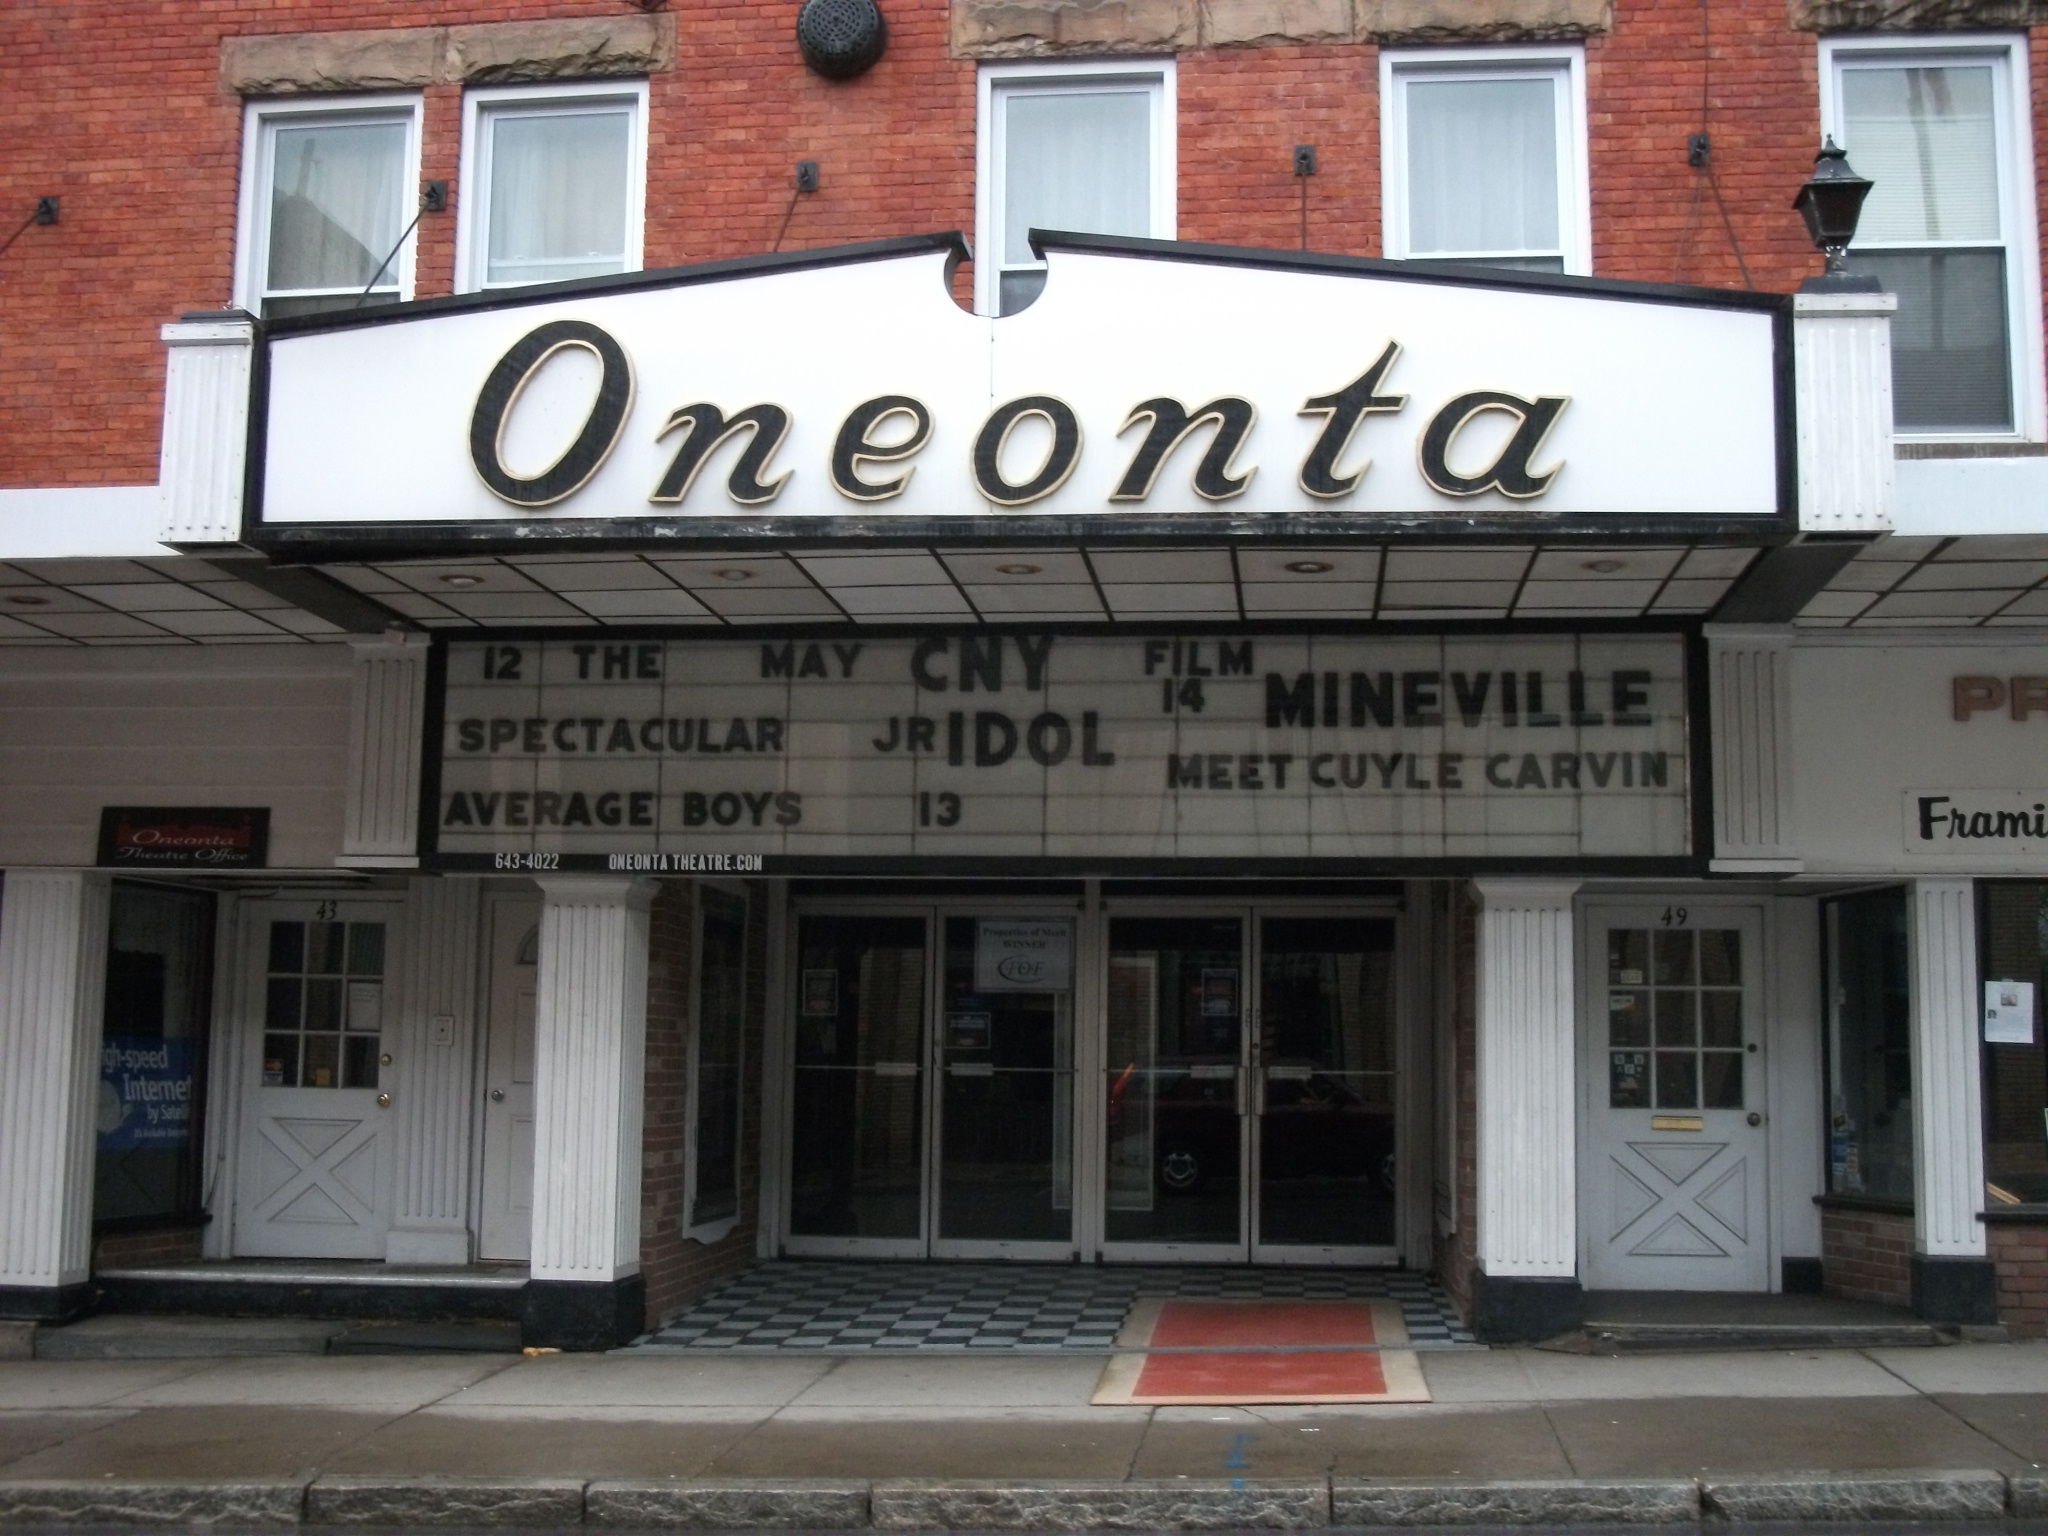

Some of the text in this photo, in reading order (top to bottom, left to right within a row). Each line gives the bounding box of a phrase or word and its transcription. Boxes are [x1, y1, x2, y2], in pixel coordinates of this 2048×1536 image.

[466, 320, 1572, 506] Oneonta
[483, 644, 661, 680] 12 THE
[761, 643, 865, 679] MAY
[911, 635, 1054, 692] CNY
[1144, 640, 1254, 677] FILM
[1162, 678, 1205, 713] 14
[1265, 671, 1653, 729] MINEVILLE
[458, 717, 784, 755] SPECTACULAR
[873, 711, 1115, 768] JR IDOL
[1167, 751, 1669, 792] MEET CUYLE CARVIN
[444, 791, 802, 828] AVERAGE BOYS
[919, 791, 962, 828] 13
[1918, 796, 2048, 840] Frami
[116, 846, 248, 863] Theatre Office
[132, 828, 235, 846] Oneonta
[495, 853, 559, 871] 643-4022
[609, 853, 763, 872] ONEONTA THEATRE.COM
[315, 900, 337, 920] 43
[1661, 906, 1688, 926] 49
